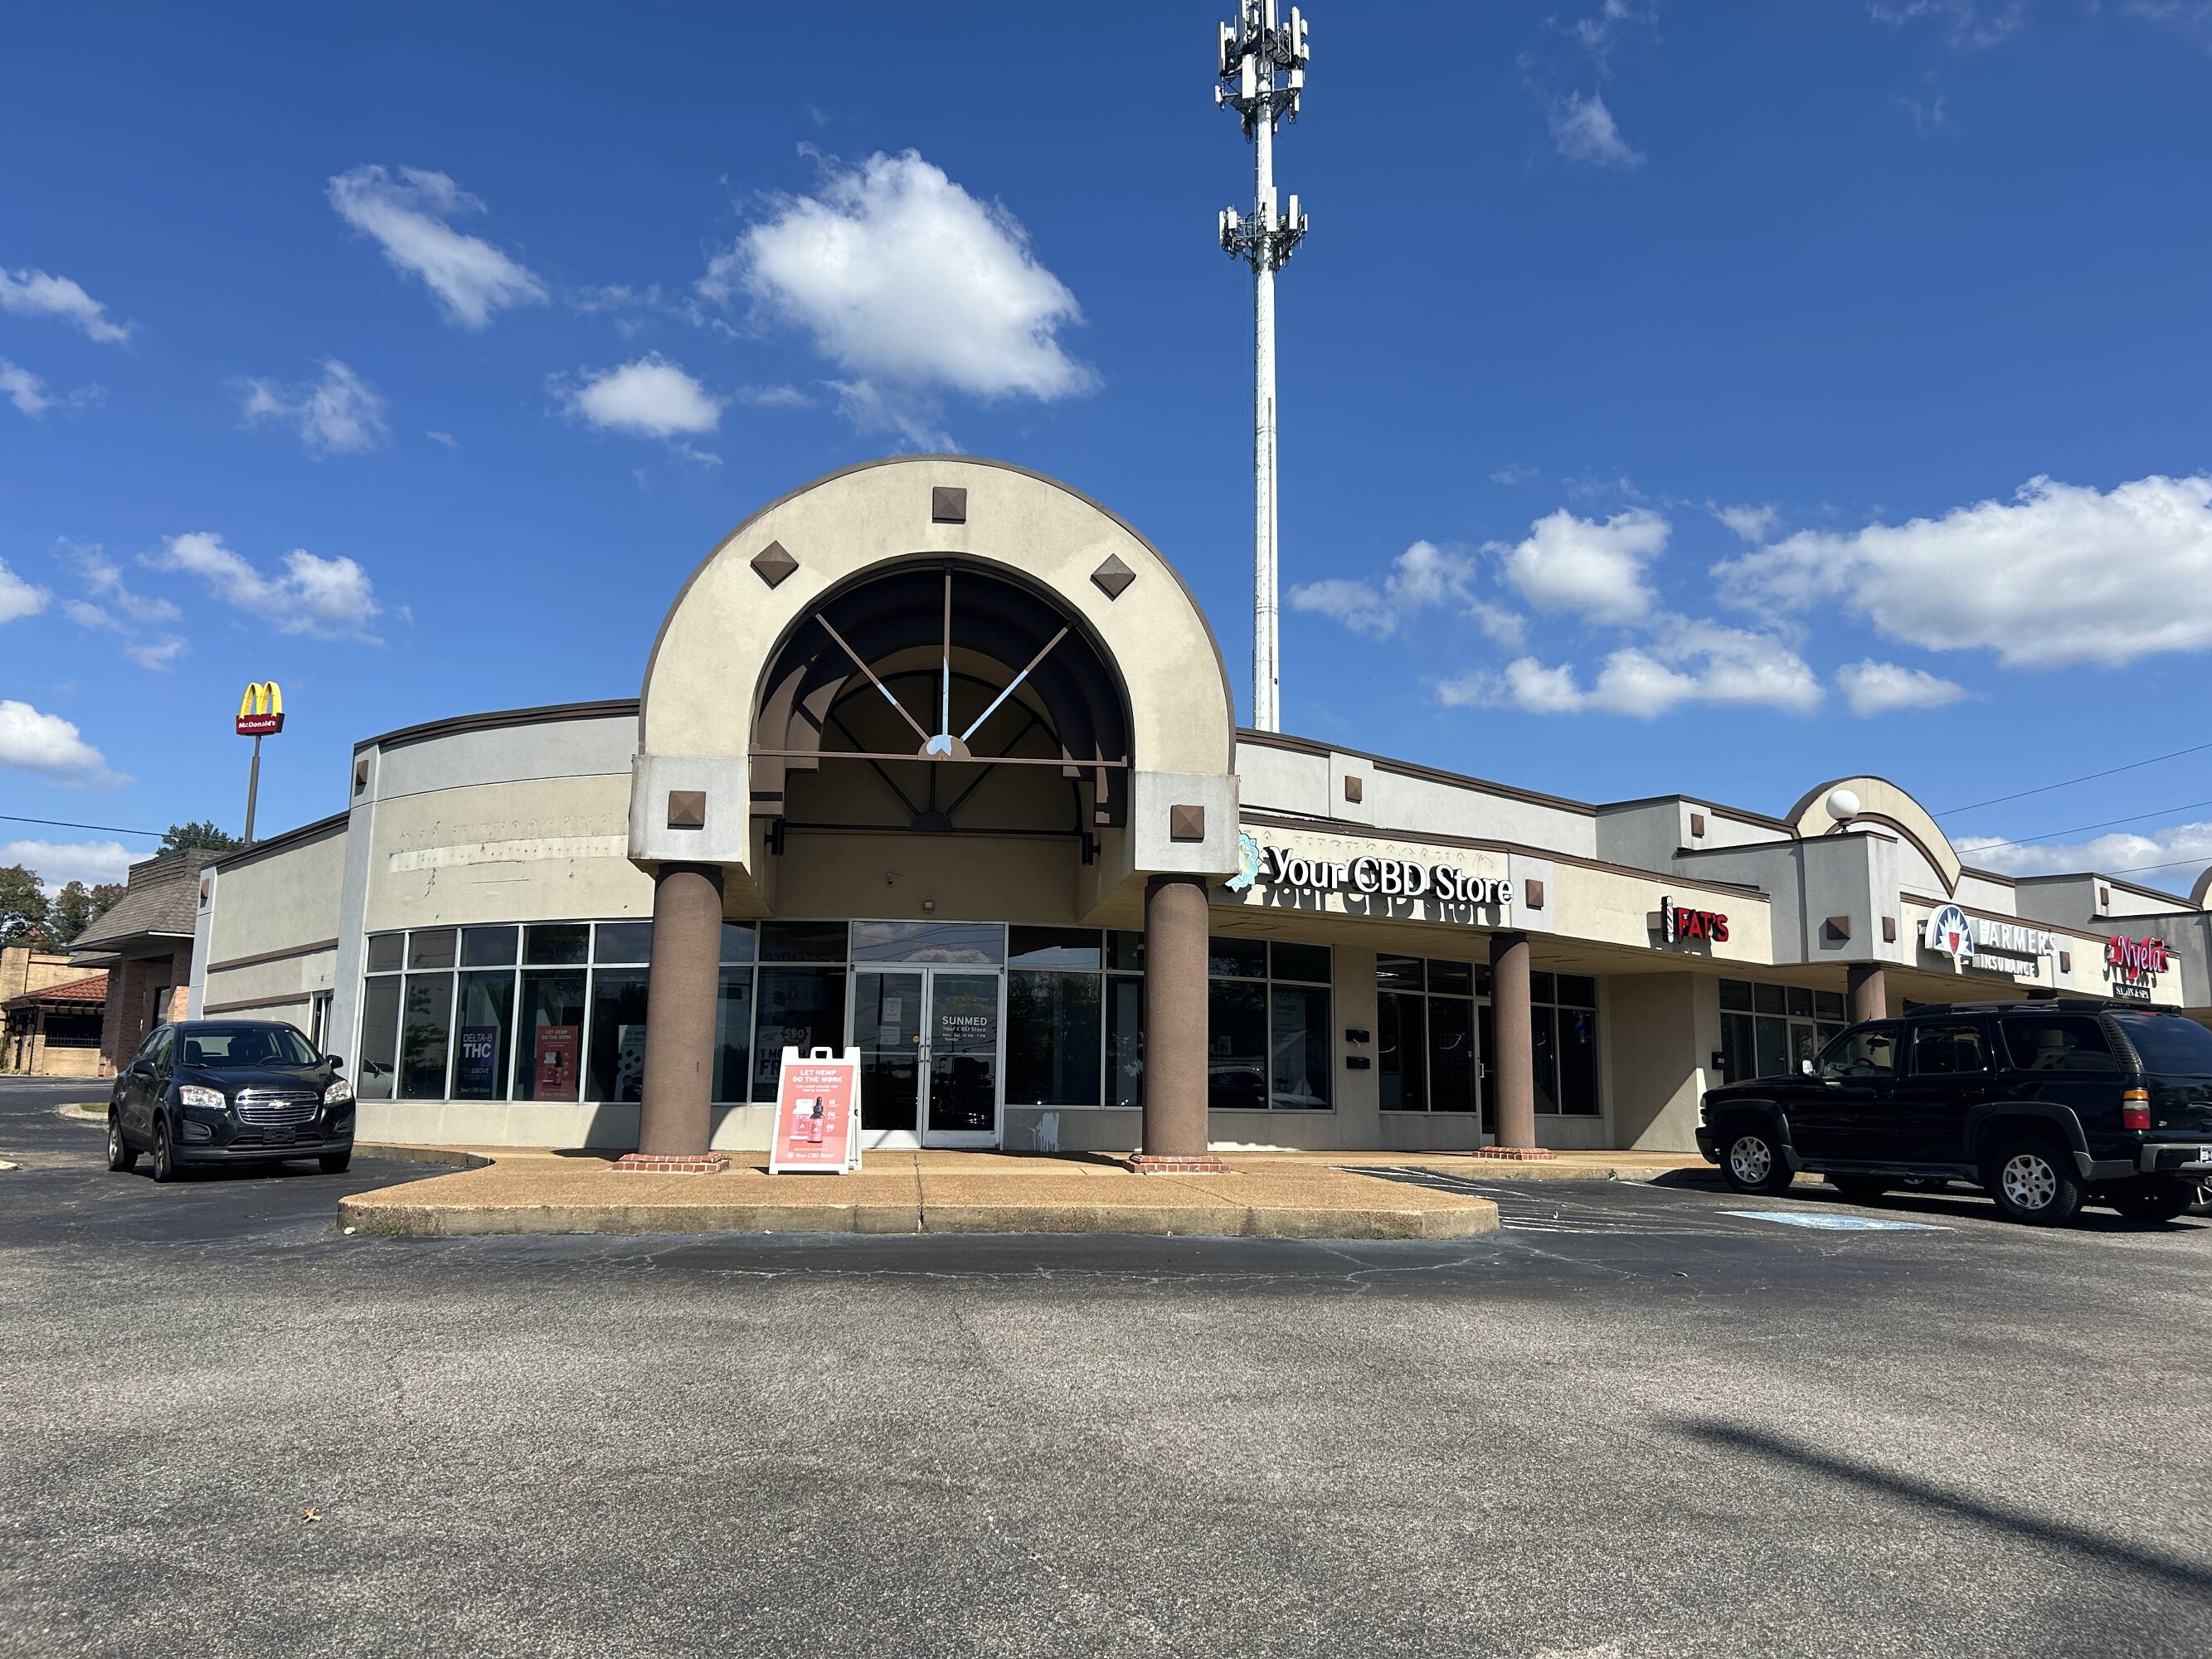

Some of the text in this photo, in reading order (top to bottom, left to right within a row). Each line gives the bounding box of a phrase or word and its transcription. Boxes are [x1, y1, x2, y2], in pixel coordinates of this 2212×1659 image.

[238, 720, 276, 728] McDonald's
[1267, 845, 1514, 905] Your CBD Store
[1676, 907, 1729, 942] FAT'S
[2117, 935, 2171, 980] Nyela's
[942, 1015, 987, 1026] SUNMED
[463, 1034, 493, 1043] DELTA-8
[785, 1029, 805, 1039] $90
[463, 1043, 492, 1058] THC
